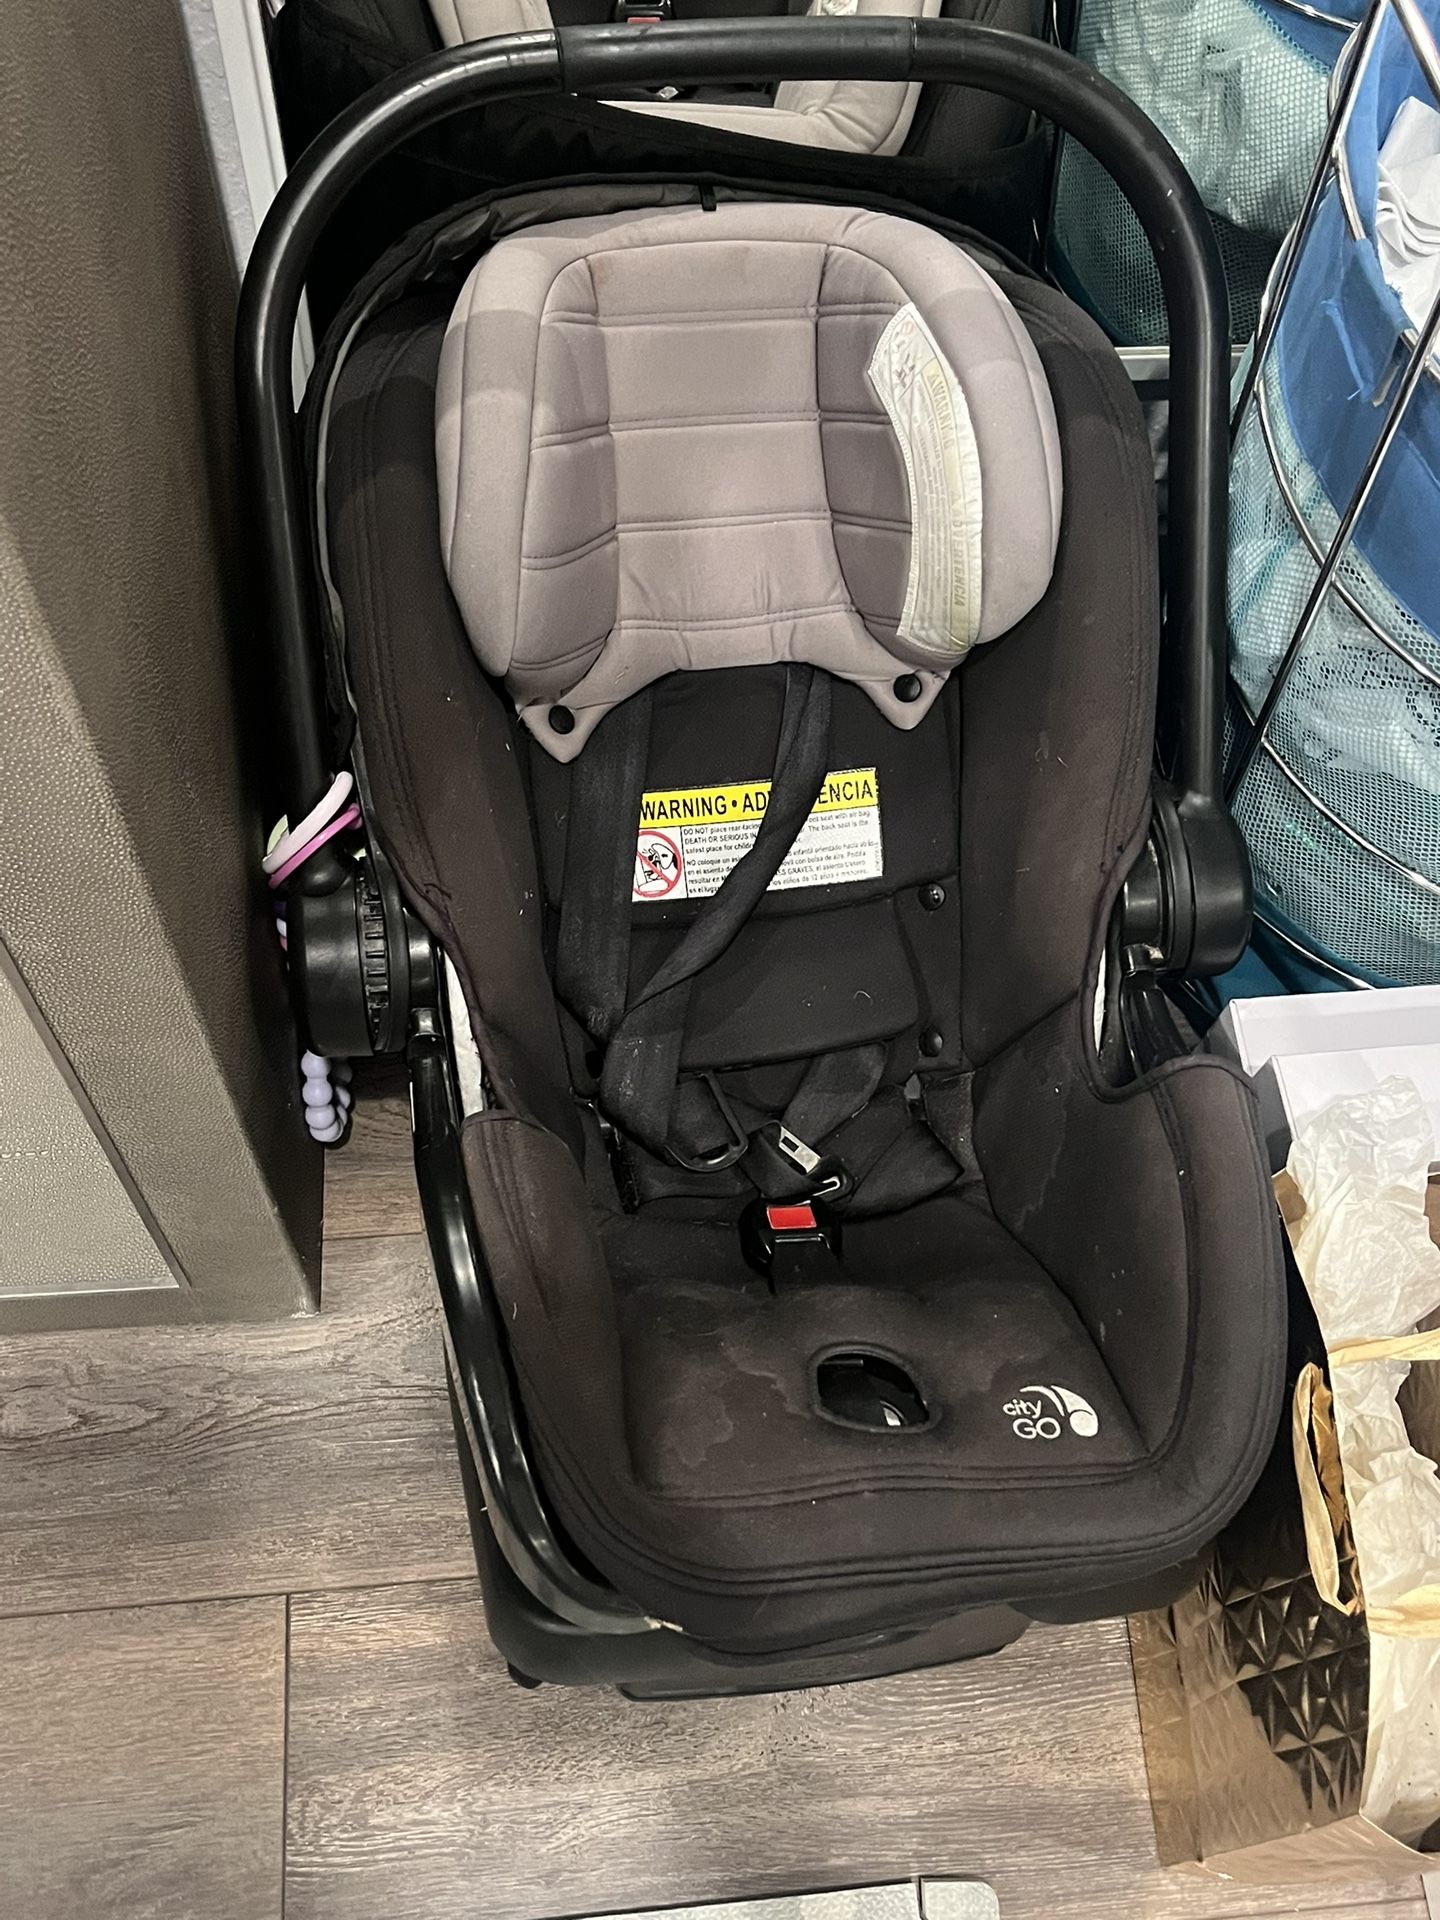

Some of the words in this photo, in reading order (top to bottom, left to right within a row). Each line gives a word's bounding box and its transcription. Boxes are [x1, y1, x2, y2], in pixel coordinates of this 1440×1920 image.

[932, 376, 954, 450] WARNING
[951, 505, 967, 607] ADVERTENCIA
[640, 795, 727, 821] WARNING
[685, 836, 706, 844] DEATH
[720, 833, 748, 841] SERIOUS
[706, 845, 722, 853] place
[1002, 1398, 1042, 1419] city
[1012, 1417, 1061, 1439] GO
